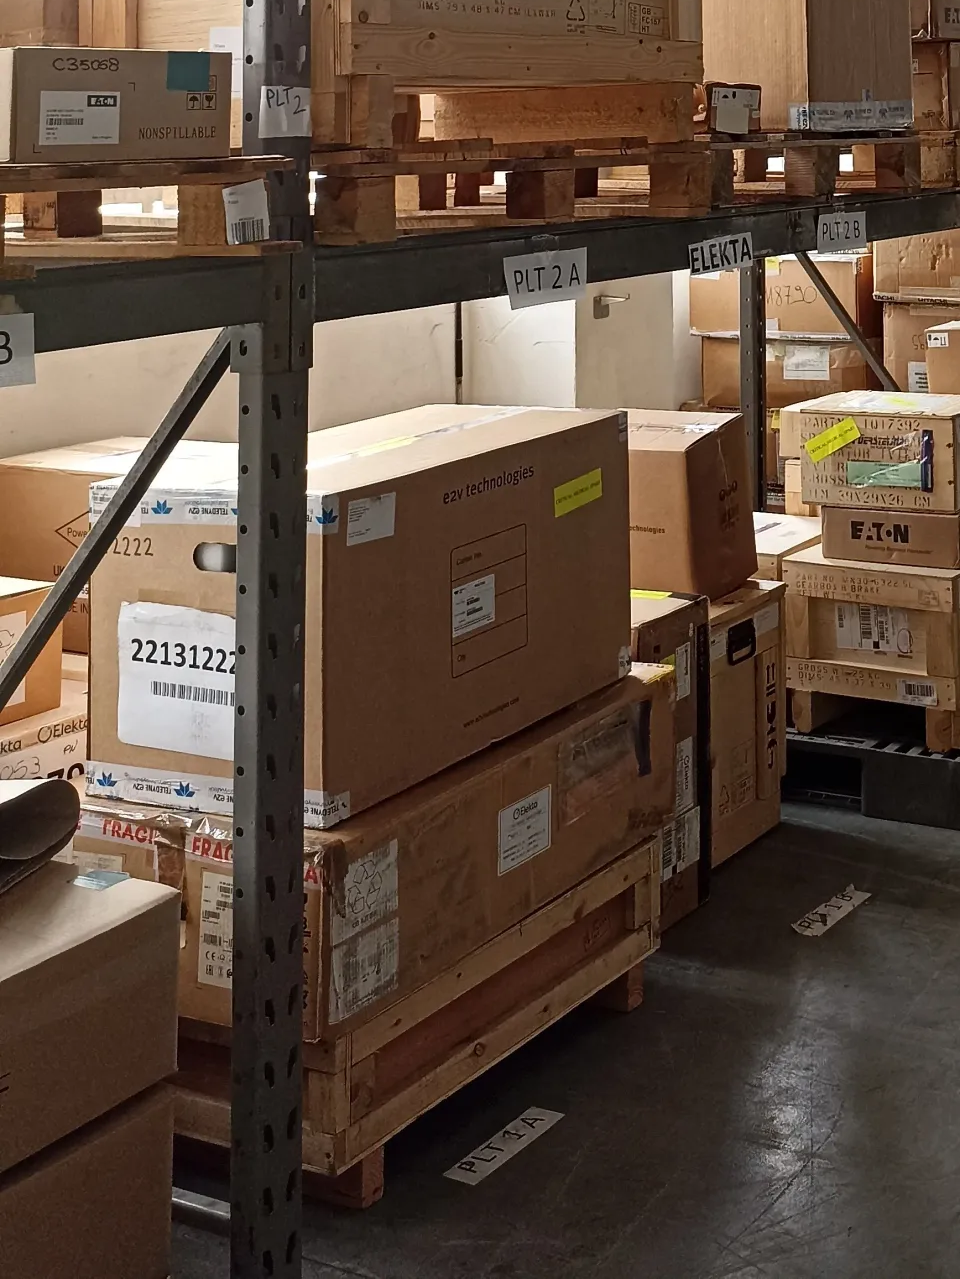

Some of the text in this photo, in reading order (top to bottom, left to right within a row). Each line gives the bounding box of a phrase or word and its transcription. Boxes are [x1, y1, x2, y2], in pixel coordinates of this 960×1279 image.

[641, 26, 650, 34] HT
[52, 57, 119, 72] C35068
[266, 88, 291, 109] PLT
[138, 126, 216, 140] NONSPILLABLE
[822, 222, 841, 241] PLT
[690, 237, 752, 273] ELEKTA
[514, 266, 546, 294] PLT
[864, 418, 921, 432] 1017392
[443, 466, 534, 505] e2v technologies
[914, 495, 931, 508] CM
[187, 506, 228, 515] e2v TELEDYNE
[67, 526, 89, 538] Powe
[629, 525, 665, 534] echnologies
[851, 521, 909, 544] EATON
[851, 584, 881, 594] BRAKE
[798, 663, 827, 674] GROSS
[0, 741, 22, 755] kta
[144, 783, 172, 796] TELEDYNE
[312, 804, 339, 818] TELEDYNE
[520, 800, 538, 817] Elekta
[457, 1141, 505, 1174] PLT
